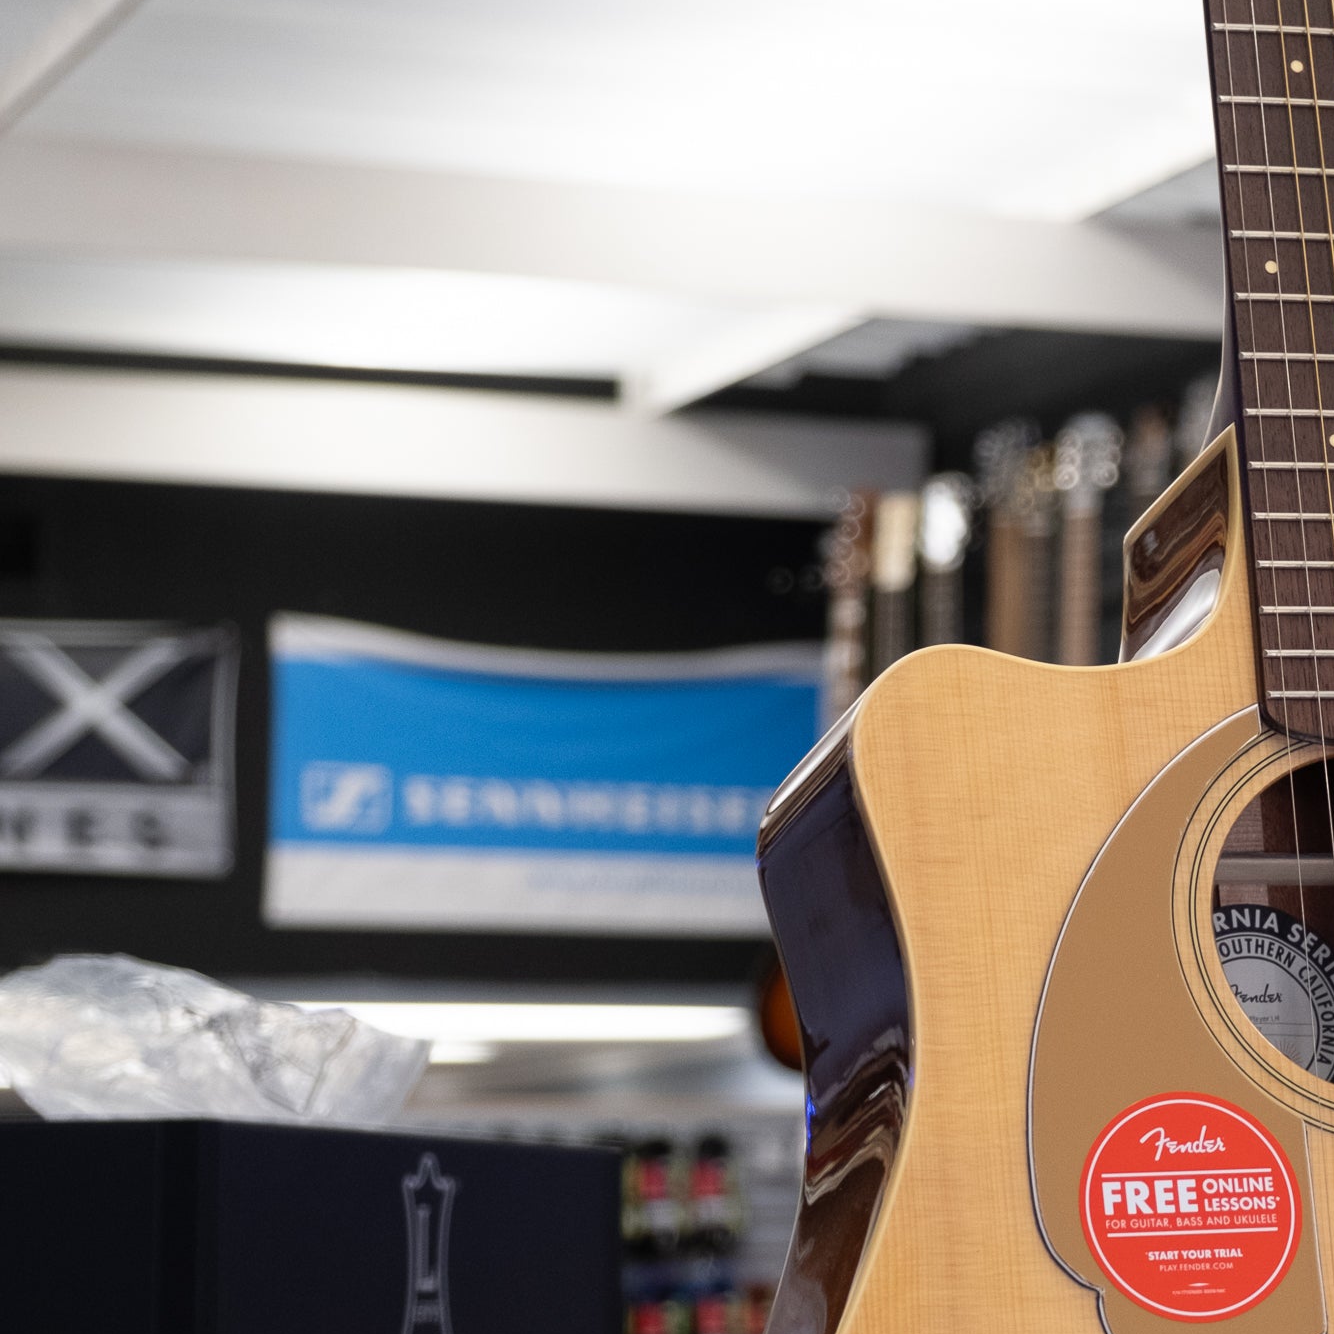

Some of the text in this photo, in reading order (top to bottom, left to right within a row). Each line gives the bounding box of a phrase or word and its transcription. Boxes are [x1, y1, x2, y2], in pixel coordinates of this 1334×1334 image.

[1140, 1125, 1226, 1161] Fender
[1202, 1176, 1274, 1194] ONLINE
[1101, 1178, 1199, 1216] FREE
[1105, 1213, 1278, 1230] FOR GUITAR, BASS AND UKULELE
[1181, 1249, 1212, 1259] YOUR
[1214, 1248, 1243, 1258] TRIAL
